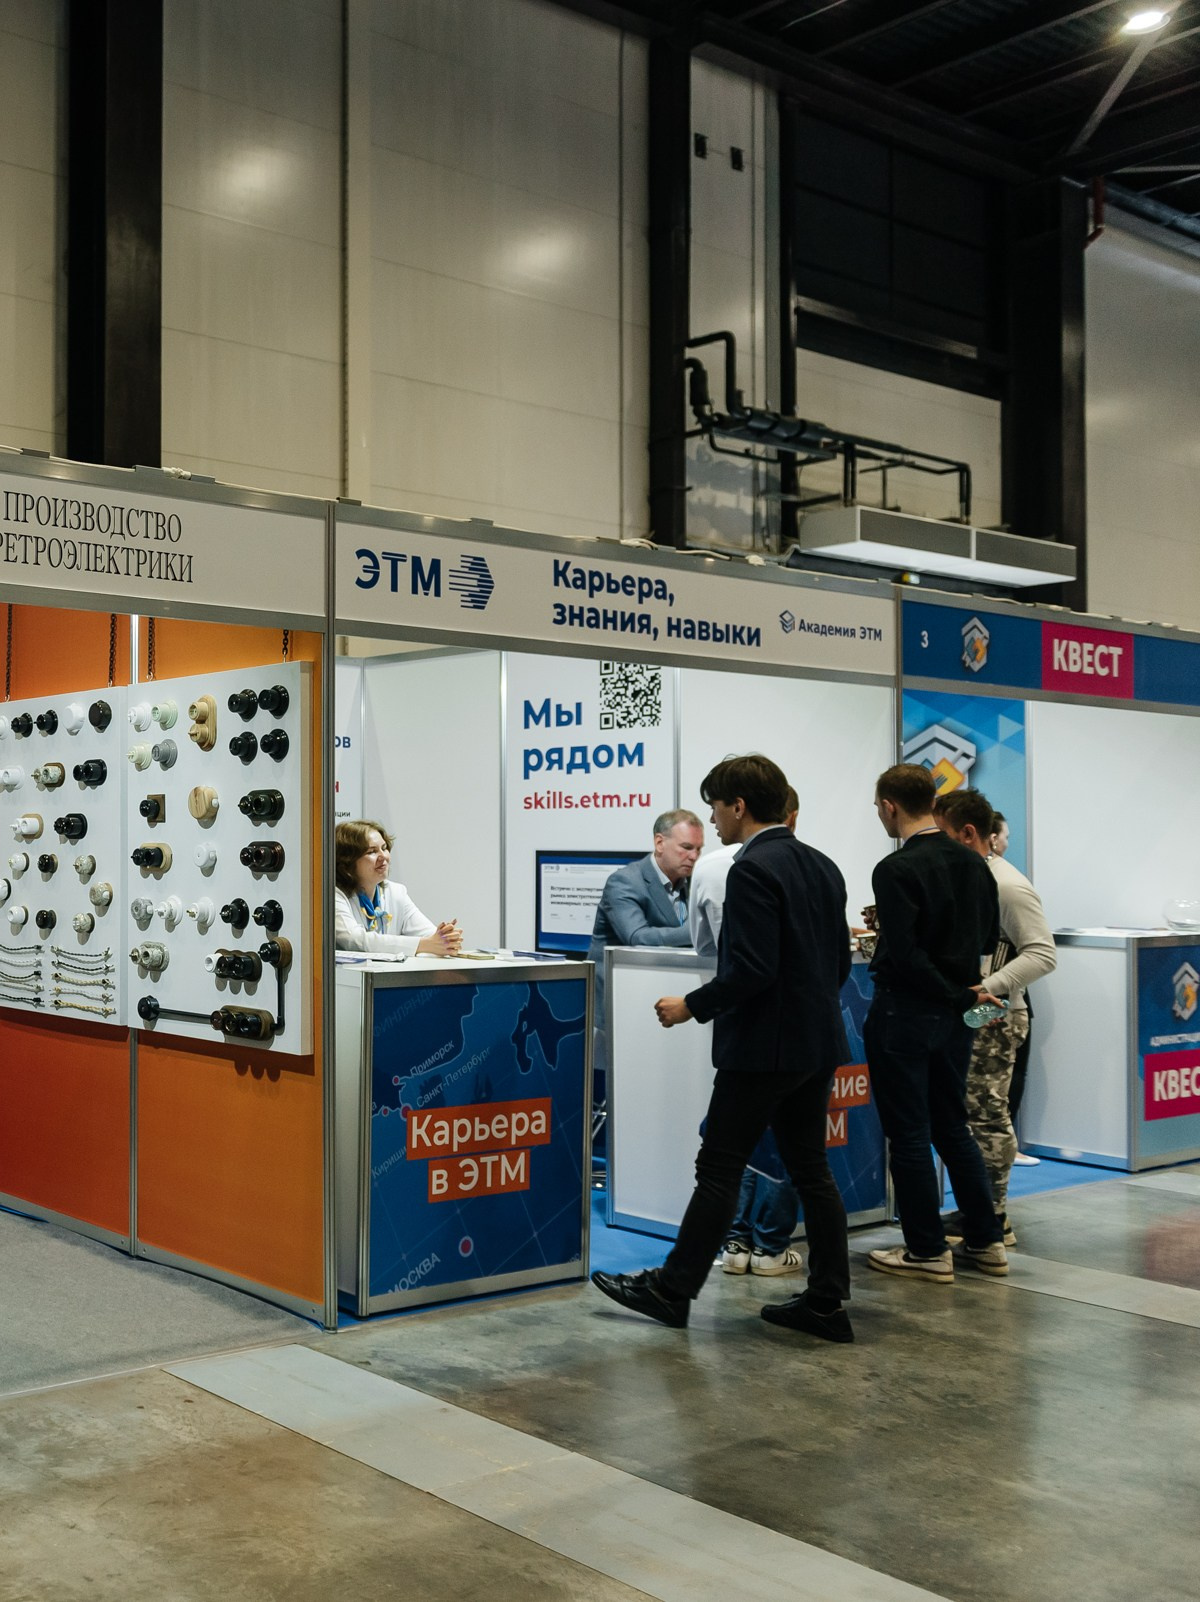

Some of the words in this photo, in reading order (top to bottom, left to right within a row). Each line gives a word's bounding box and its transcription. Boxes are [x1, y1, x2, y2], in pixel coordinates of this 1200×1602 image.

[3, 490, 183, 544] ПРОИЗВОДСТВО
[354, 548, 442, 598] ЭТМ
[552, 559, 676, 607] Карьера,
[552, 602, 659, 642] знания,
[666, 616, 762, 648] навыки
[798, 618, 856, 639] Академия
[859, 626, 883, 642] ЭТМ
[920, 630, 929, 648] 3
[1052, 638, 1123, 678] КВЕСТ
[523, 698, 583, 729] Мы
[523, 741, 645, 781] рядом
[523, 788, 652, 811] skills.etm.ru
[409, 1040, 455, 1077] Приморск
[416, 1046, 491, 1108] Санкт-Петербург
[1153, 1065, 1200, 1102] КВЕС
[411, 1109, 547, 1152] Карьера
[431, 1168, 449, 1195] в
[458, 1151, 526, 1191] ЭТМ
